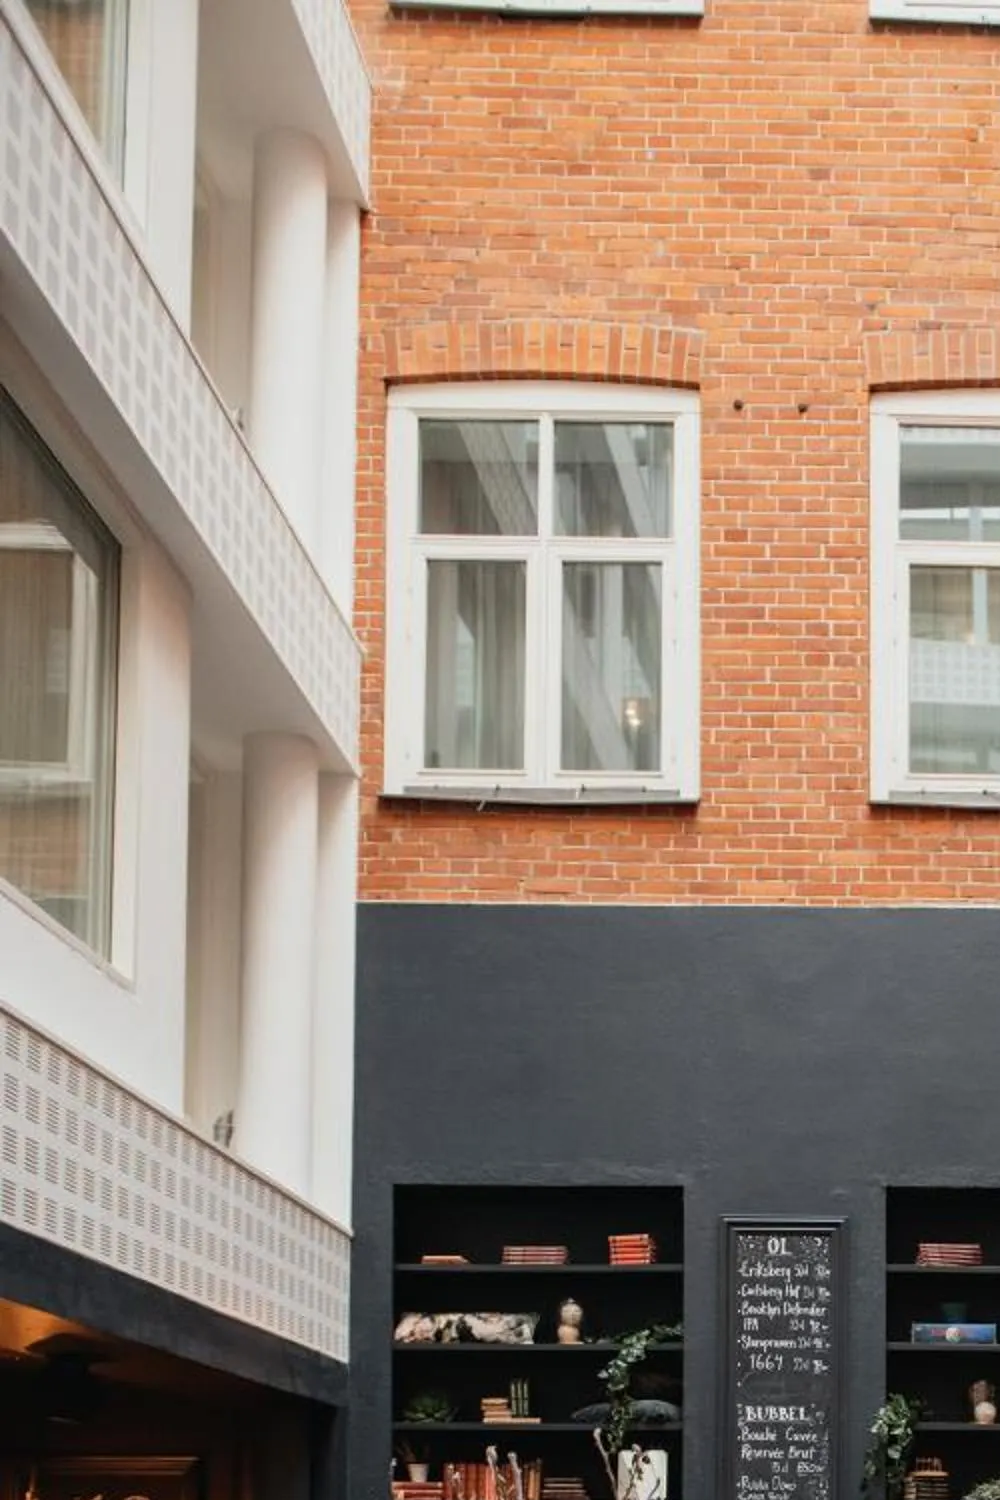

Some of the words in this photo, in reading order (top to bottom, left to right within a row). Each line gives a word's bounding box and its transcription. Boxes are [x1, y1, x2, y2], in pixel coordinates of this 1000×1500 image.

[741, 1283, 783, 1301] Carlsberg
[750, 1353, 783, 1372] 1664
[744, 1404, 812, 1422] BUBBEL
